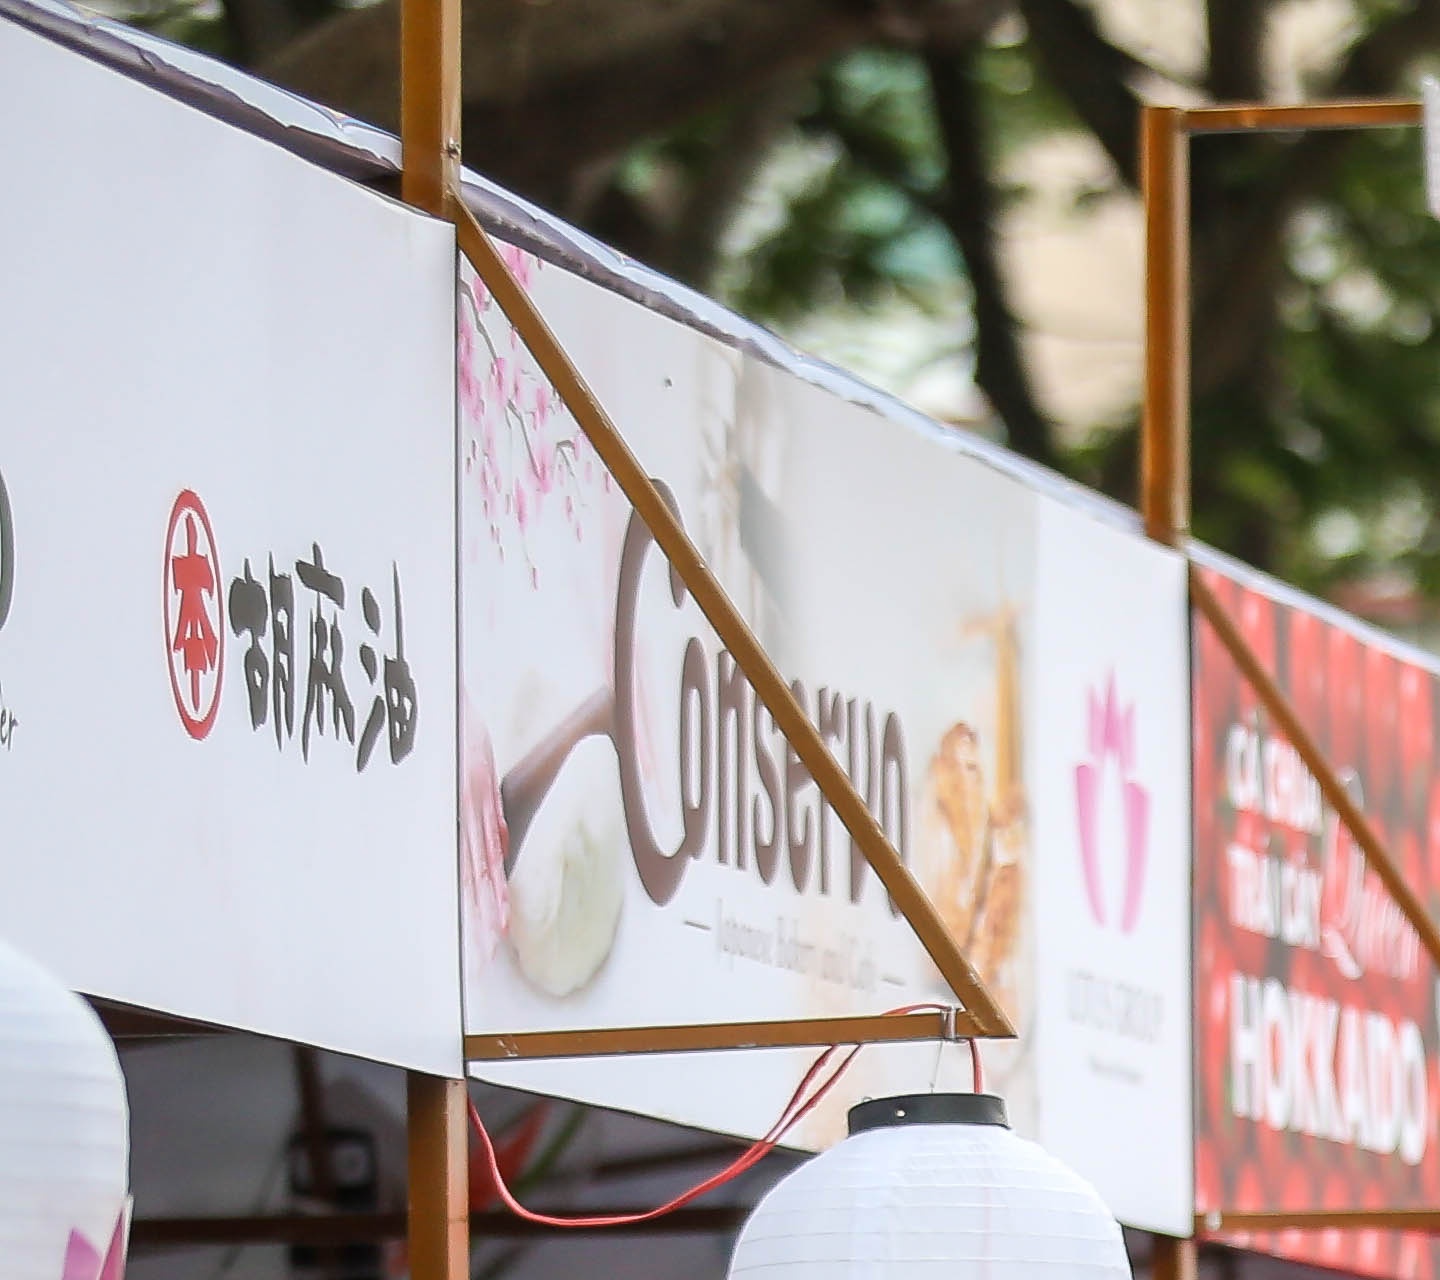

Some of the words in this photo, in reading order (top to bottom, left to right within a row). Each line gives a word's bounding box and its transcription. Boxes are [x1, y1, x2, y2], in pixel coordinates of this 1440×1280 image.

[228, 542, 417, 774] 胡麻油
[614, 478, 911, 920] Conservo
